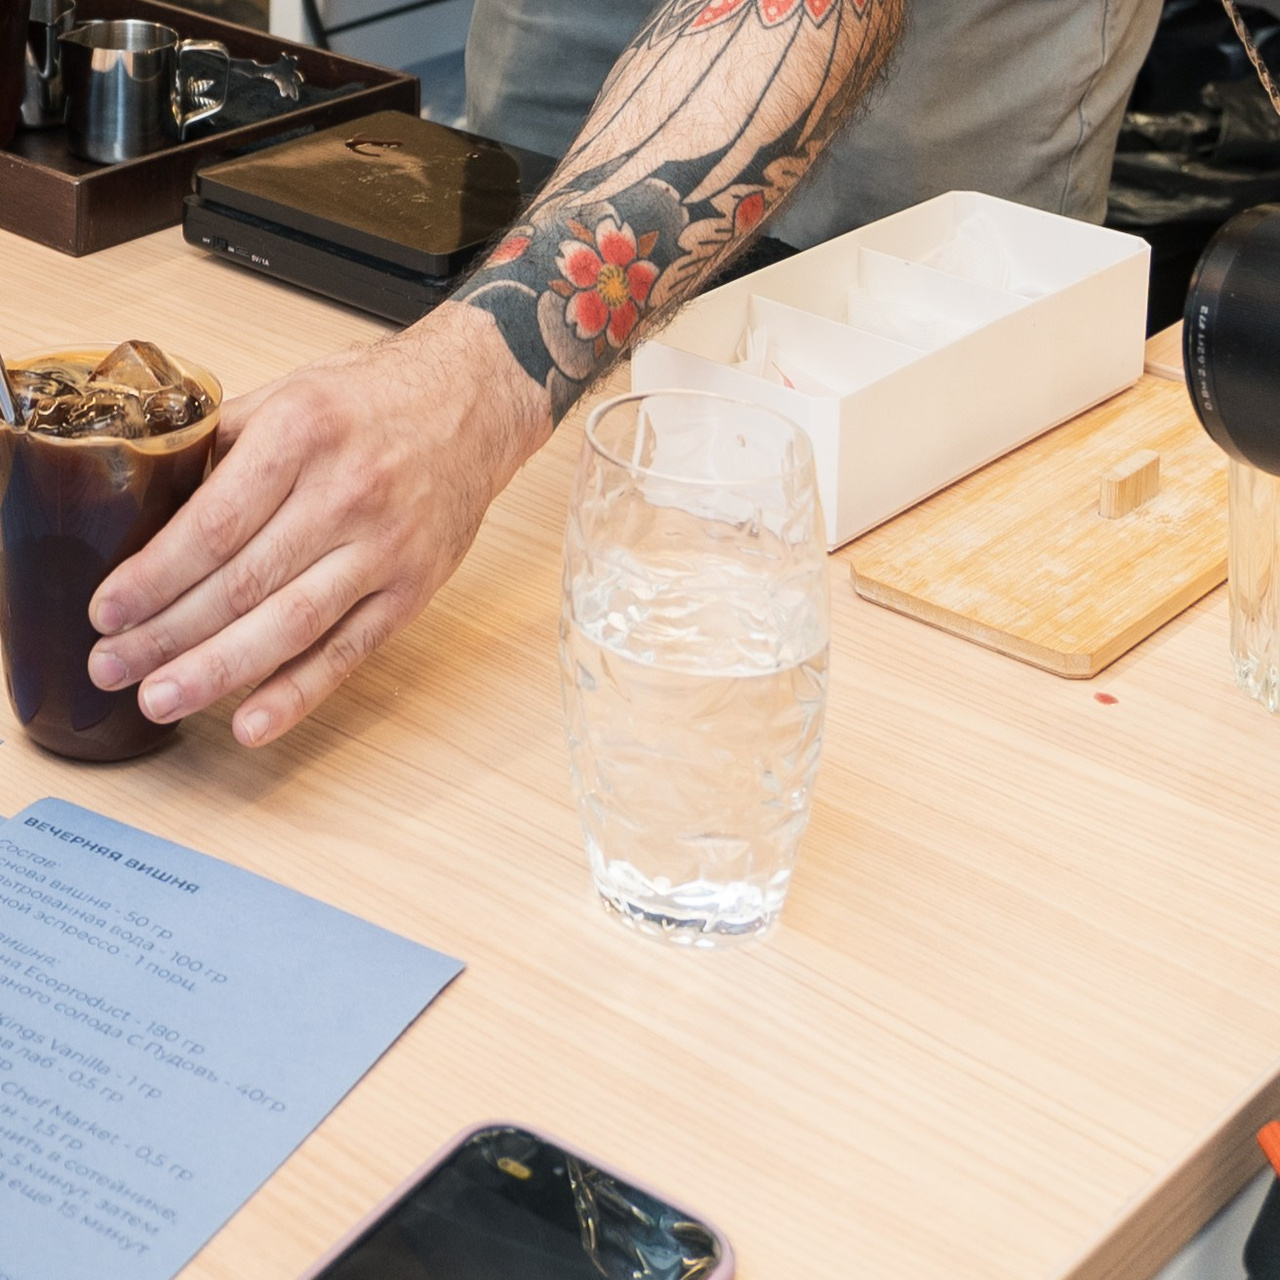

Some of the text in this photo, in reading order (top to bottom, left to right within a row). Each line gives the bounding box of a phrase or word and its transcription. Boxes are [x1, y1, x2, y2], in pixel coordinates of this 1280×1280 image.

[22, 816, 200, 894] ВЕЧЕРНЯЯ ВИШНЯ
[32, 910, 120, 955] эспрессо
[48, 878, 111, 910] вишня
[123, 910, 150, 927] 50
[150, 924, 173, 939] гр
[108, 924, 155, 952] вода
[169, 950, 204, 972] 100
[203, 967, 228, 983] гр
[22, 964, 132, 1021] Ecoproduct
[181, 1038, 205, 1054] гр
[52, 1001, 124, 1038] солода
[16, 1046, 57, 1068] лаб
[98, 1085, 124, 1102] гр
[49, 1037, 111, 1075] Vanilla
[137, 1082, 162, 1099] гр
[0, 1080, 52, 1109] Chef
[47, 1103, 120, 1145] Market
[167, 1163, 194, 1181] гр
[58, 1133, 84, 1150] гр
[6, 1152, 24, 1166] 5
[95, 1198, 160, 1236] затем
[7, 1178, 54, 1205] еще
[56, 1198, 79, 1219] 15
[79, 1214, 150, 1255] минут
[63, 1158, 177, 1225] сотейнике,
